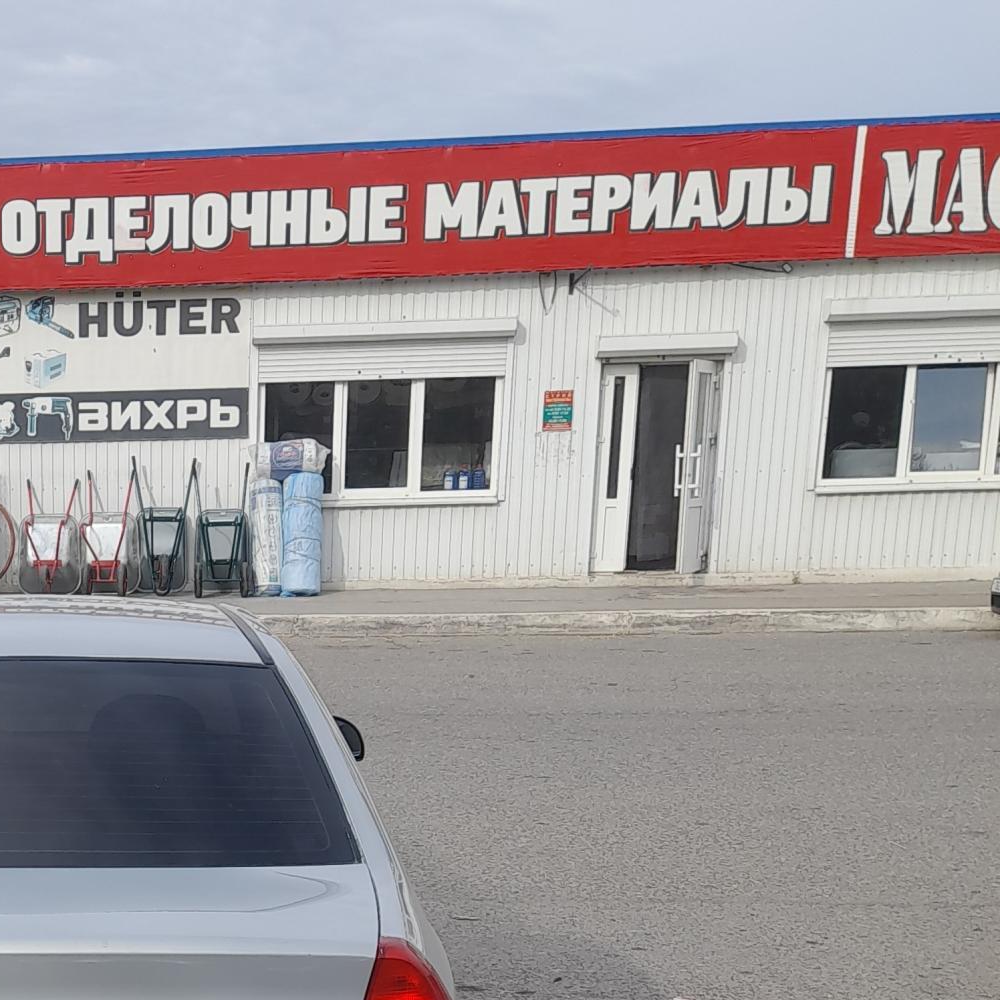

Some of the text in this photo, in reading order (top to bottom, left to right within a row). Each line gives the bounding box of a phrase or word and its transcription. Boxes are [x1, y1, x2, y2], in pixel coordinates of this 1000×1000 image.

[0, 184, 406, 264] ОТДЕЛОЧНЫЕ
[424, 164, 834, 241] МАТЕРИАЛЫ
[78, 290, 242, 338] HÜTER
[78, 398, 241, 433] ВИХРЬ
